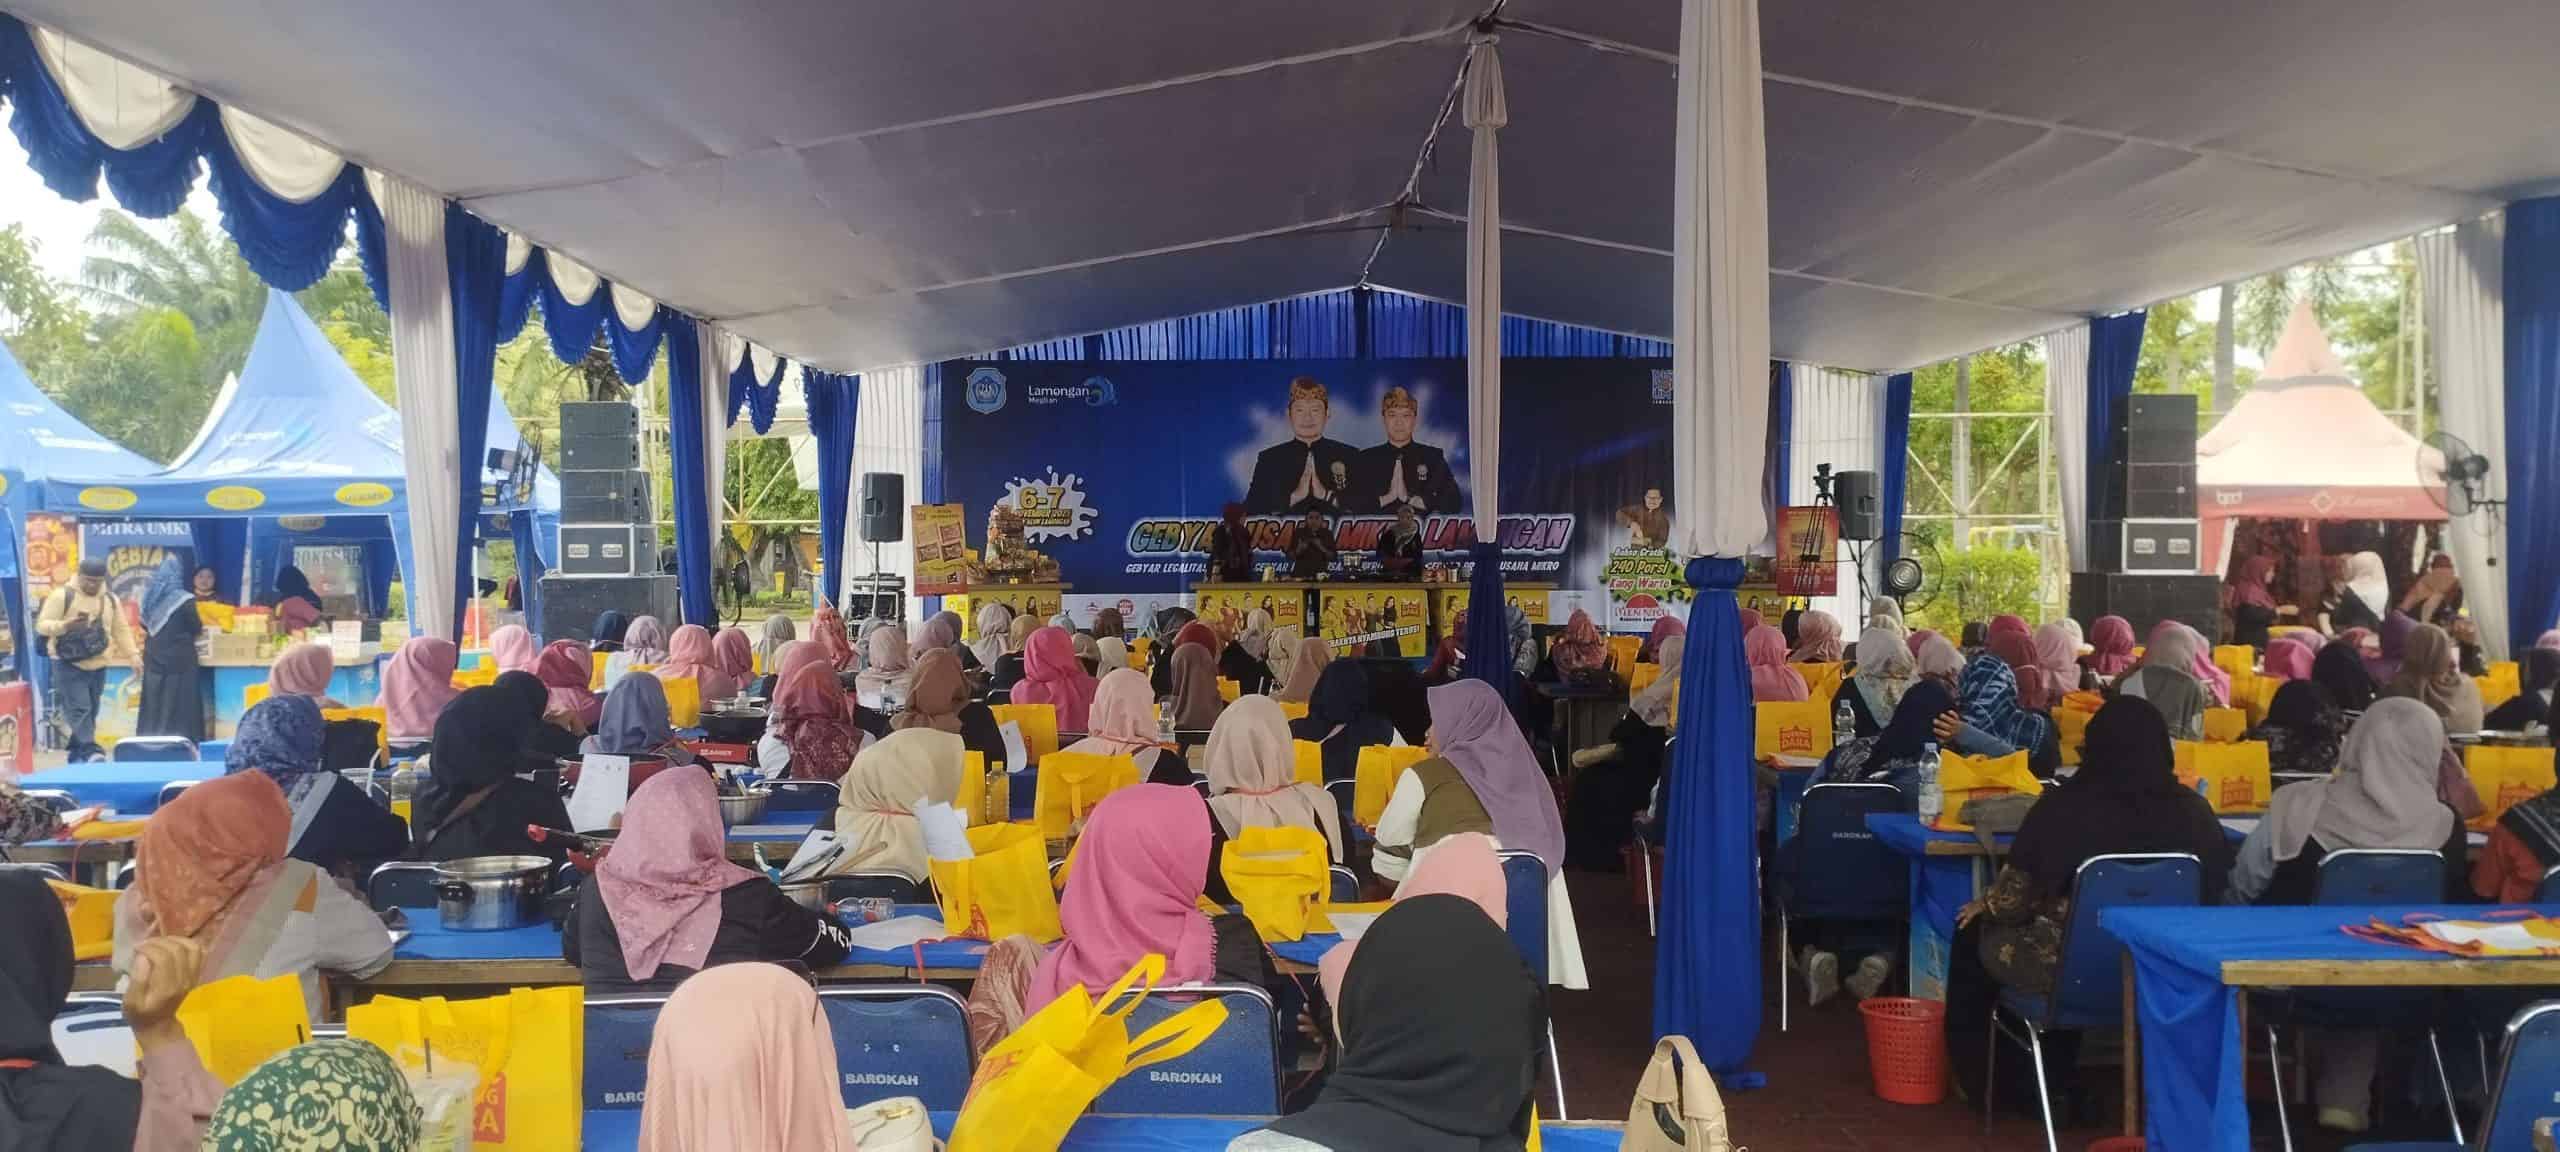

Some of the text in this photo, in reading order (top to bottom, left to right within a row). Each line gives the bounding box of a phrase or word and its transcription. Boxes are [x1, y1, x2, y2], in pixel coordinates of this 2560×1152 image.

[1028, 385, 1089, 399] Lamongan
[1021, 486, 1066, 509] 6-7
[1130, 520, 1214, 552] GEBYA
[1335, 518, 1387, 551] MIK
[1422, 517, 1571, 551] LAMNGAN
[107, 545, 174, 577] GEBYA
[1608, 558, 1636, 574] 240
[845, 1073, 919, 1086] BAROKAH
[1149, 1071, 1223, 1084] BAROKAH
[605, 1092, 645, 1105] BARO
